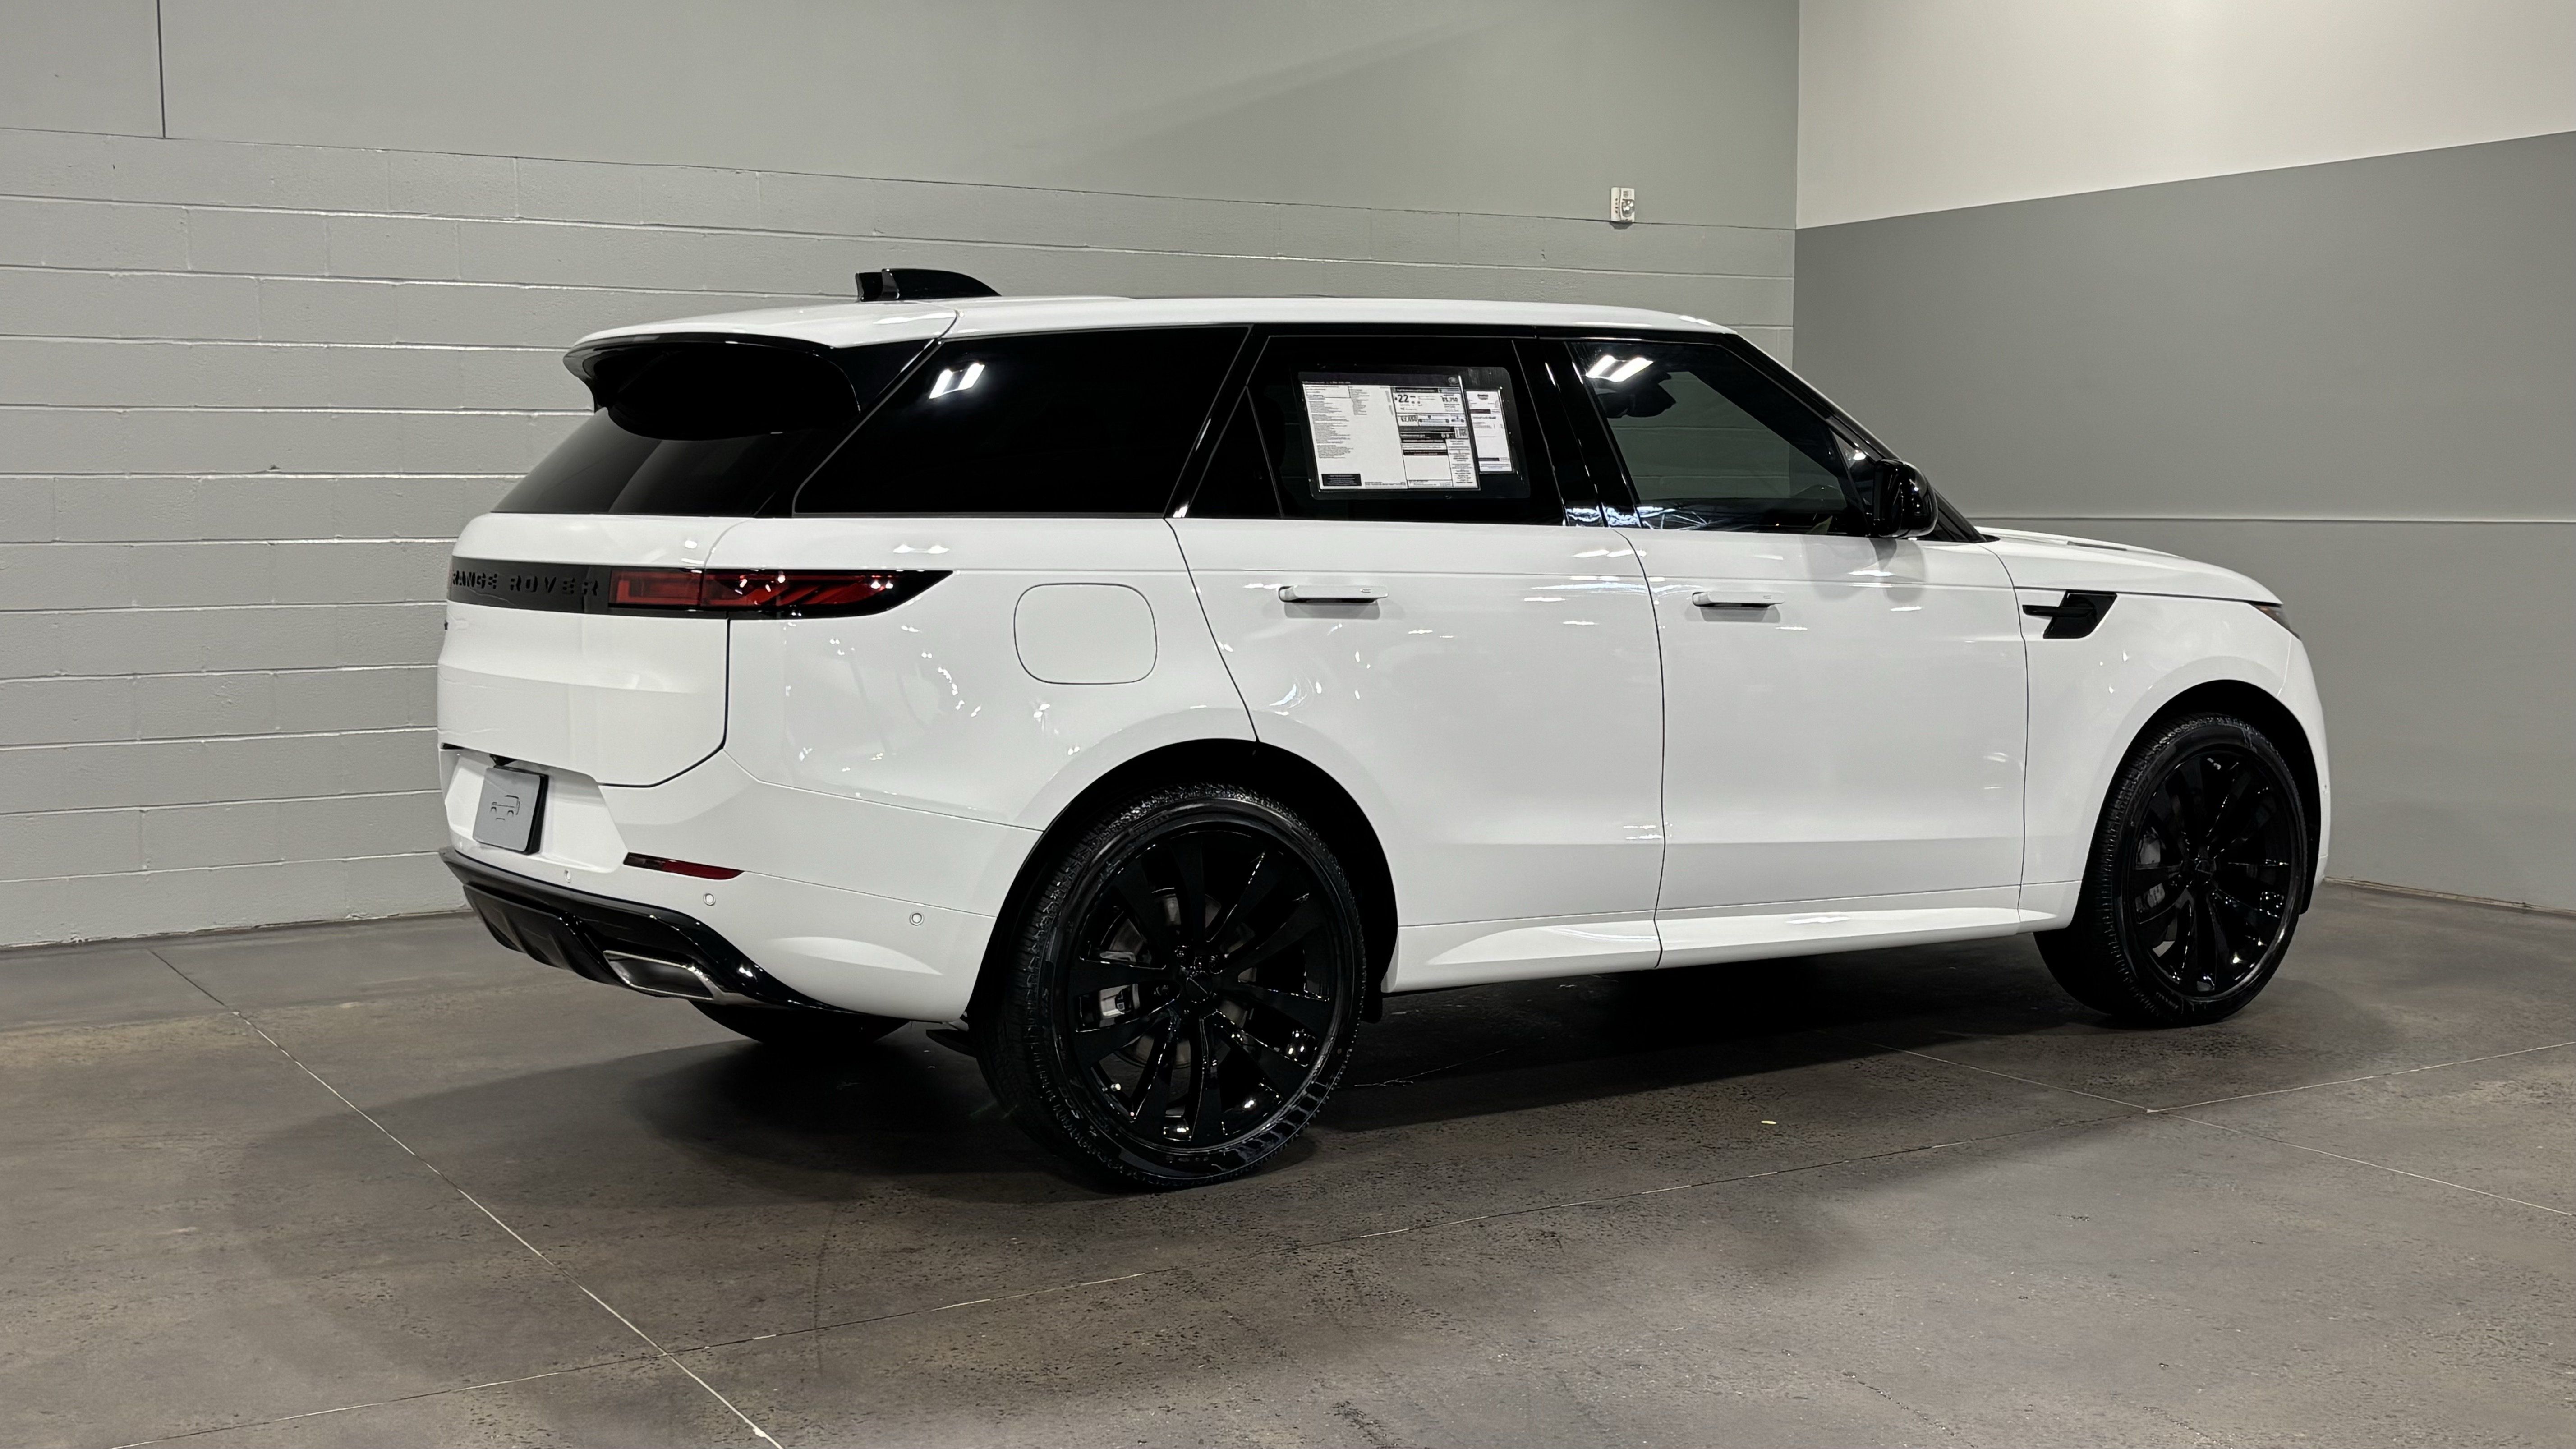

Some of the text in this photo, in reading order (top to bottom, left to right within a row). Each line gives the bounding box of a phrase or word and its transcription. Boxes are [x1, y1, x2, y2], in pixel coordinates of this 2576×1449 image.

[1398, 394, 1409, 403] 22
[452, 570, 599, 596] RANGE ROVER
